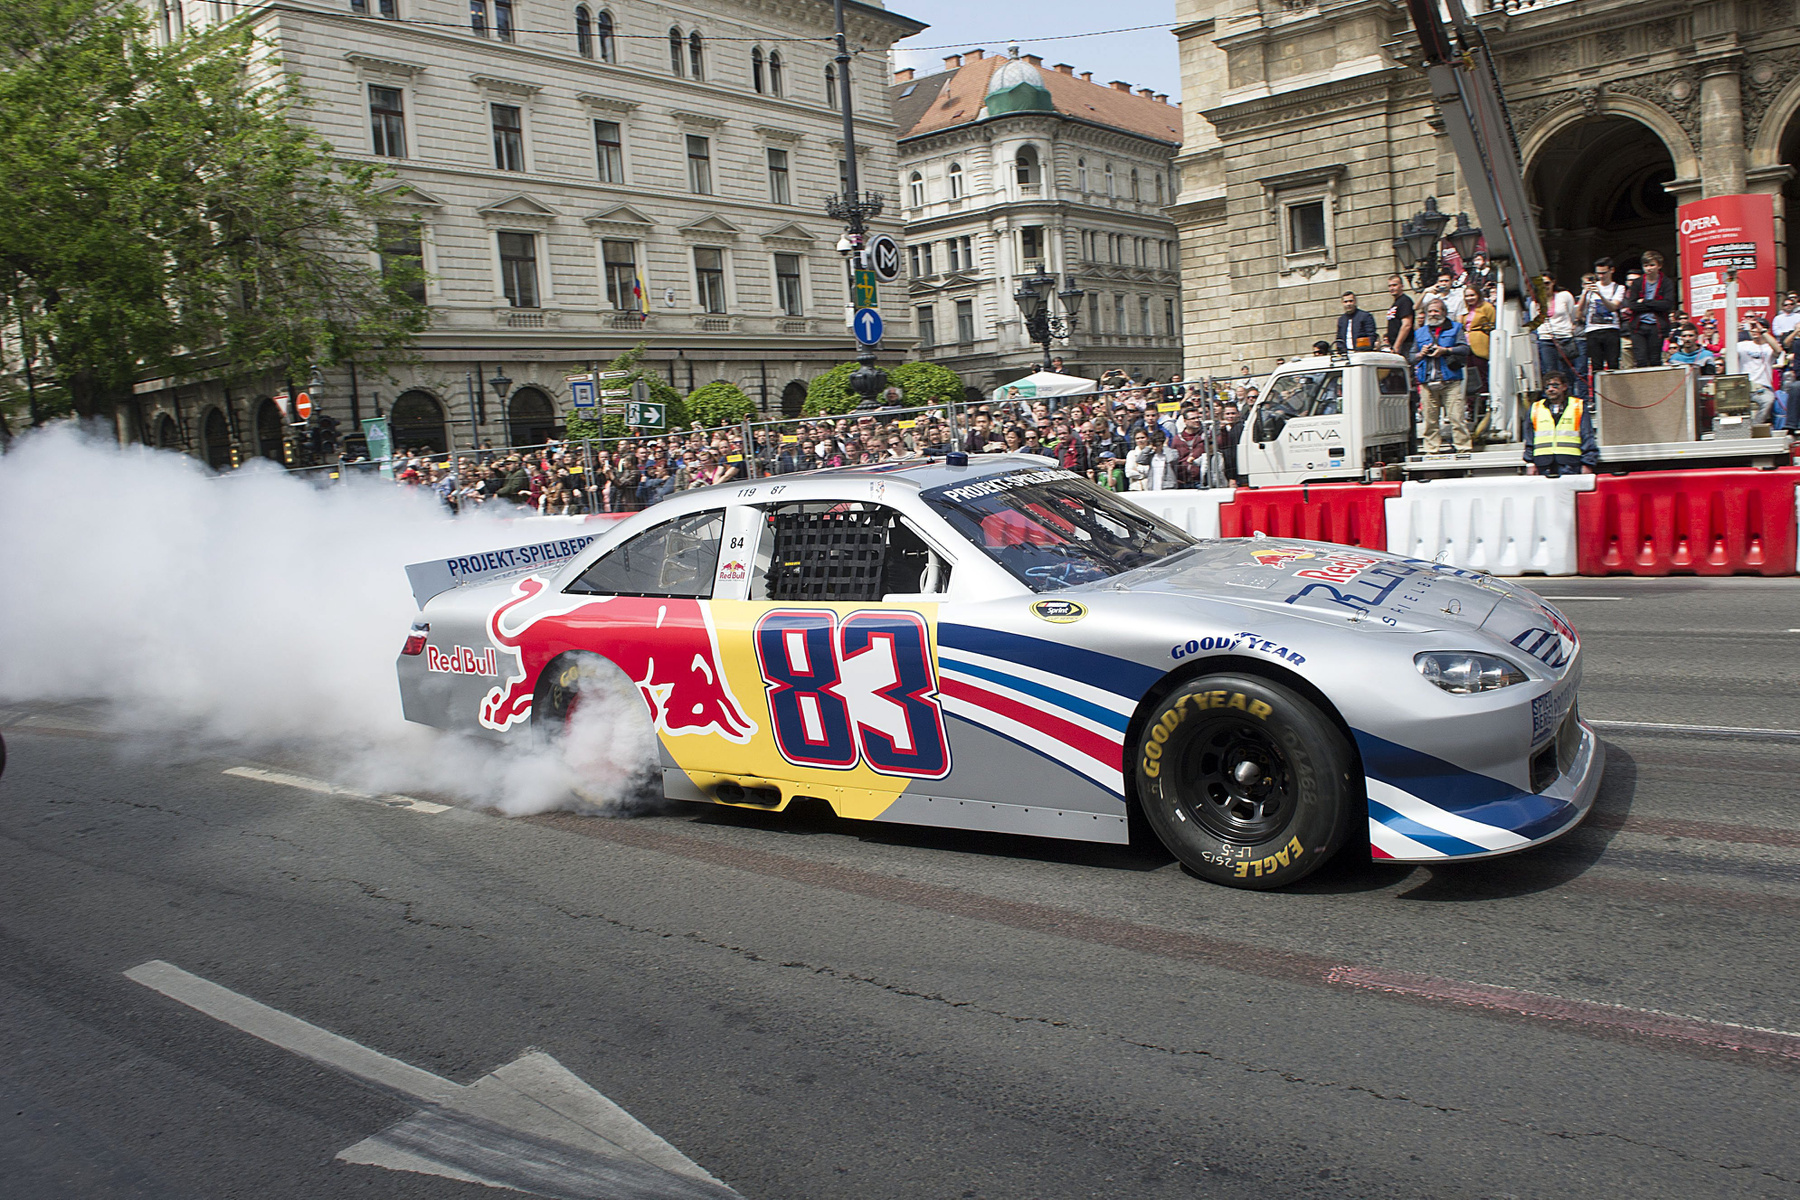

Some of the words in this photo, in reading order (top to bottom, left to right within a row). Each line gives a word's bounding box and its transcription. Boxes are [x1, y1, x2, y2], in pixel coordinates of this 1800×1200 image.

[1681, 215, 1721, 235] OPERA
[1289, 429, 1341, 443] MTVA
[738, 487, 757, 497] 119
[770, 485, 787, 495] 87
[730, 537, 744, 549] 84
[719, 571, 732, 579] Red
[732, 571, 746, 579] Bull
[1047, 607, 1069, 615] Sprint
[427, 645, 462, 672] Red
[463, 646, 497, 676] Bull
[753, 608, 953, 782] 83
[1143, 690, 1274, 779] GOODYEAR
[1233, 835, 1304, 878] EAGLE
